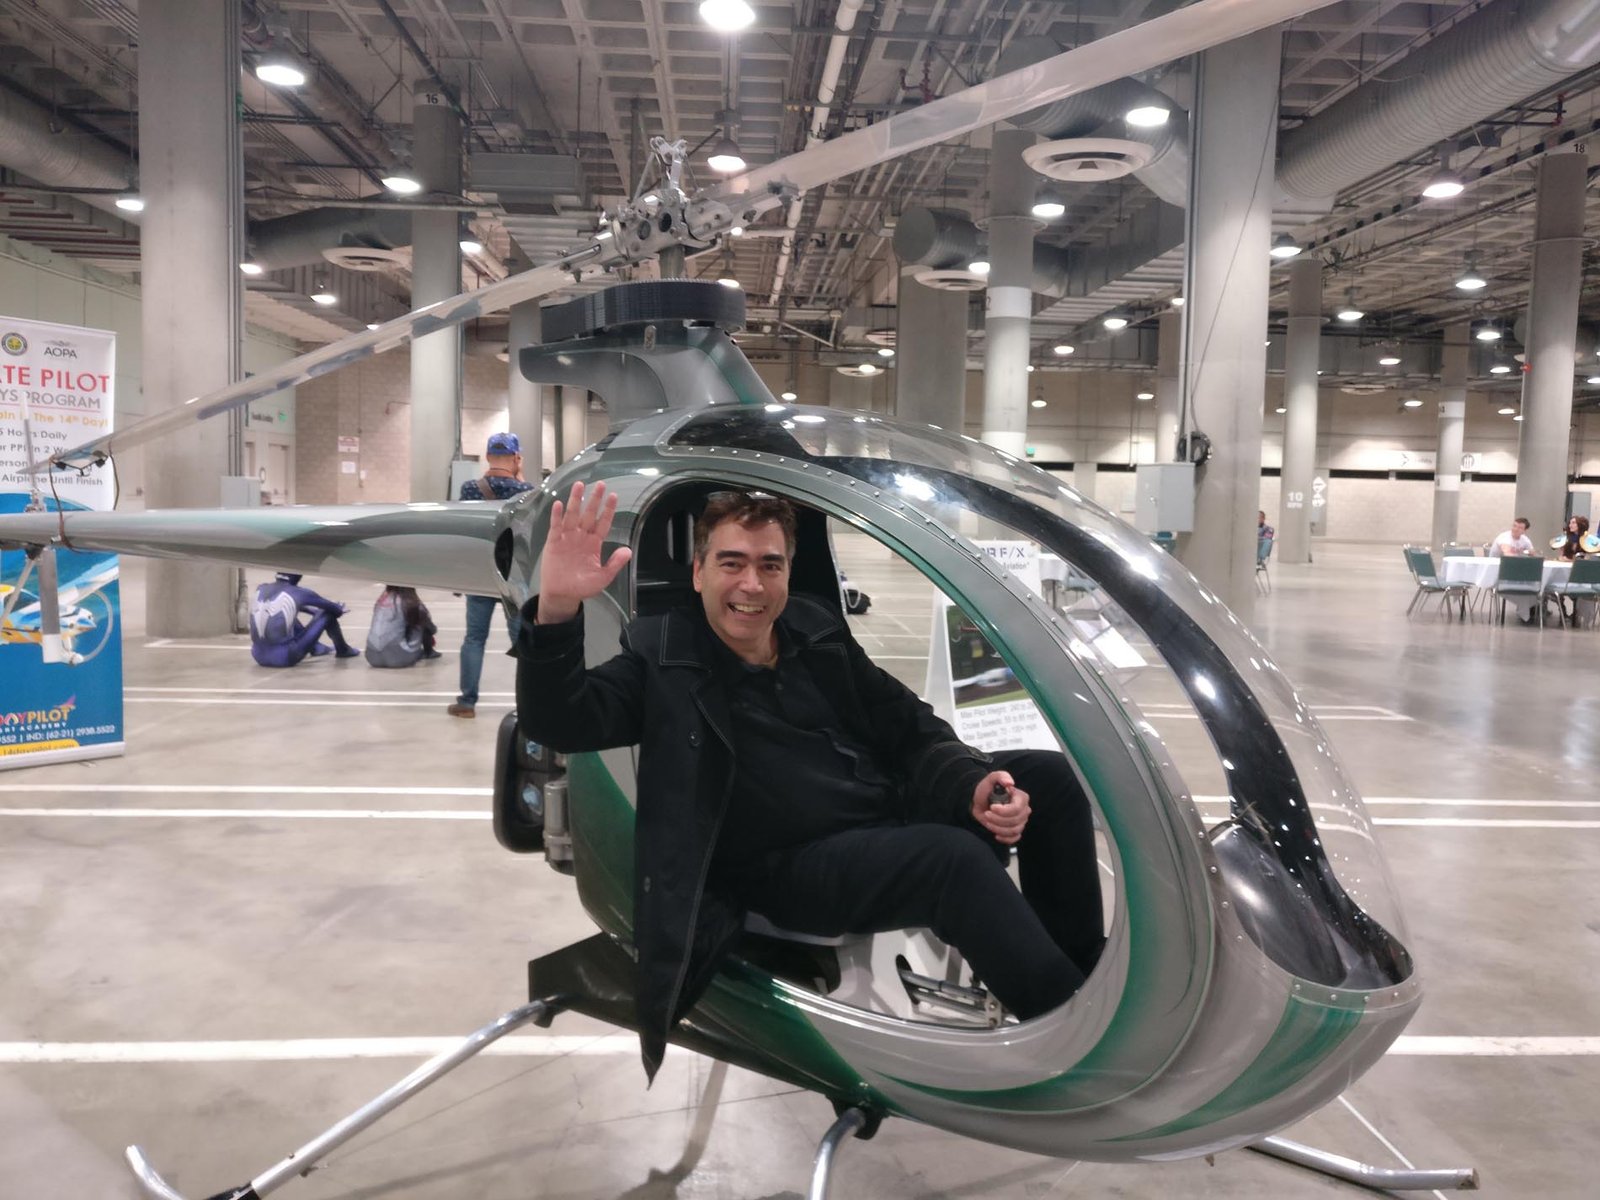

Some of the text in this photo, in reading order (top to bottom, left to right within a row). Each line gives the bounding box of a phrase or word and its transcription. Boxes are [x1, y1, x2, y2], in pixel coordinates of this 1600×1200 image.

[425, 93, 439, 105] 16
[1573, 143, 1586, 154] 18
[43, 346, 78, 359] AOPA
[0, 364, 110, 393] TE PILOT
[7, 428, 38, 439] Hos
[40, 430, 68, 440] Daily
[2, 473, 48, 484] Airplne
